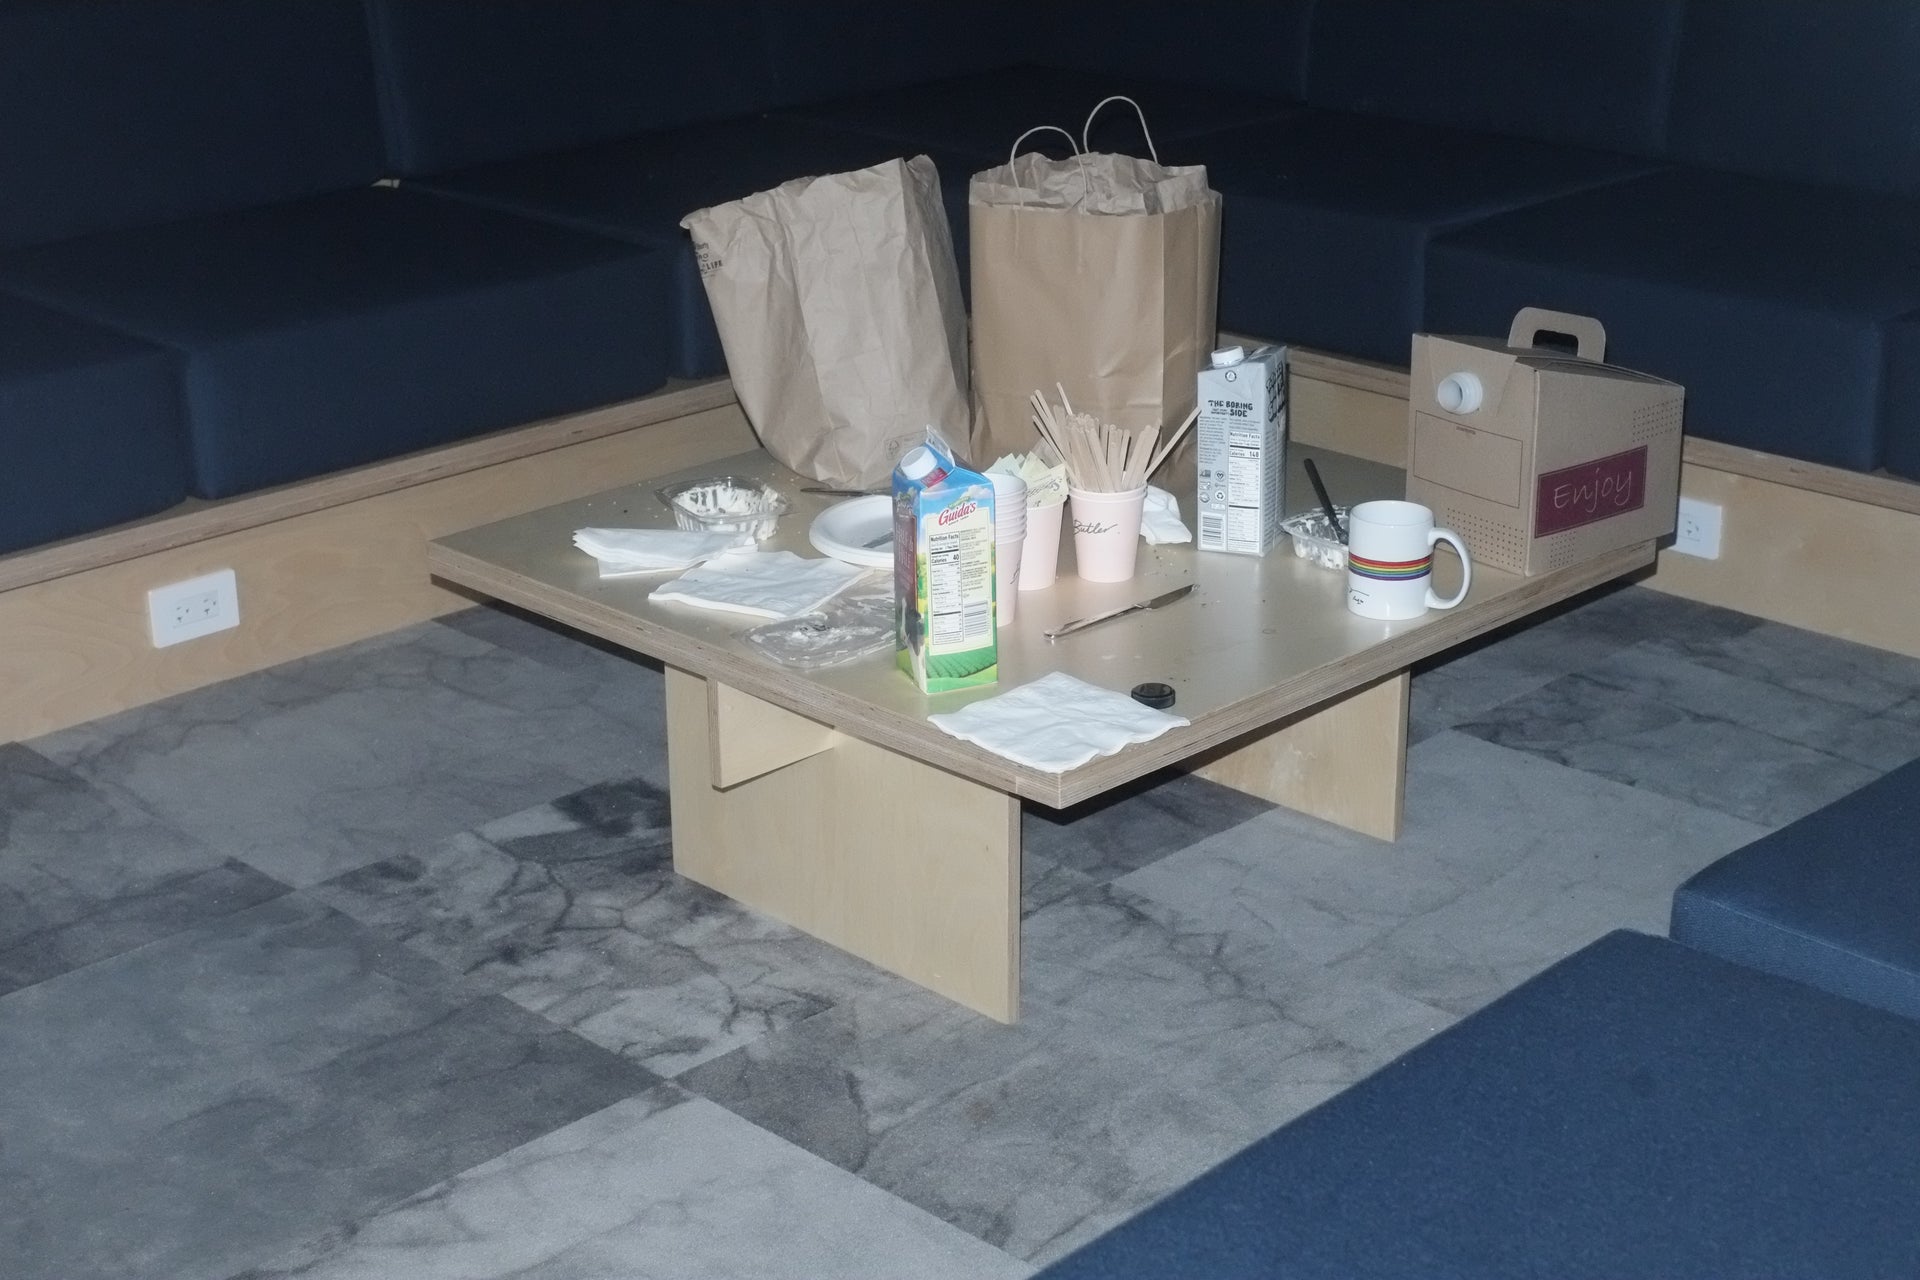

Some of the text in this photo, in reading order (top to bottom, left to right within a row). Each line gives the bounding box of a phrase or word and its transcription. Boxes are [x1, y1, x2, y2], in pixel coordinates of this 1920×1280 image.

[1207, 399, 1253, 411] THE BORING
[1229, 408, 1248, 418] SIDE
[1249, 450, 1260, 458] 140
[1553, 467, 1632, 513] Enjoy
[938, 501, 977, 526] Guida's
[1073, 519, 1118, 536] Butler
[952, 553, 960, 561] 40
